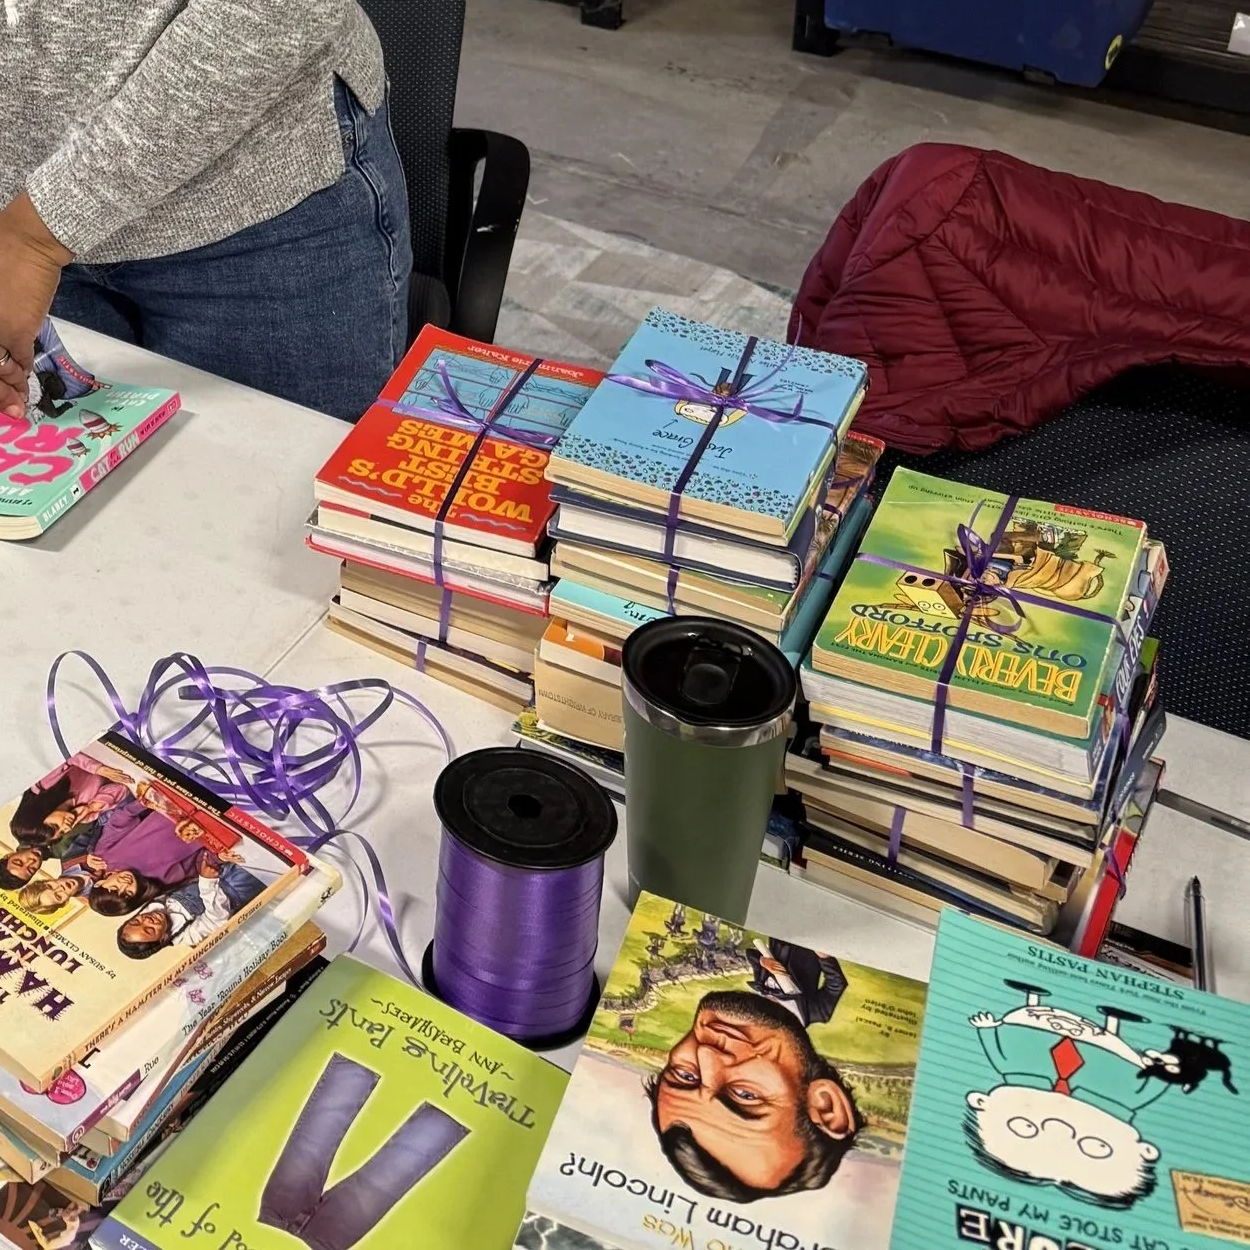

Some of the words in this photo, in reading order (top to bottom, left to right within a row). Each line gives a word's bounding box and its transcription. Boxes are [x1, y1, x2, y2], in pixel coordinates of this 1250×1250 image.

[651, 428, 694, 449] Grace
[41, 494, 69, 523] BLABEY
[1054, 505, 1128, 528] SCHOLASTIC
[834, 616, 950, 668] CLEARY
[850, 603, 1003, 649] SPOFFORD
[954, 643, 1084, 703] BEVERLY
[1011, 641, 1088, 669] OTIS
[228, 811, 286, 851] SCHOLASTIC
[13, 942, 40, 965] IN
[48, 927, 81, 957] CLYMER
[188, 924, 230, 966] LUNCHBOX
[1026, 944, 1090, 975] PASTIS
[78, 951, 107, 976] SUSAN
[181, 1019, 198, 1037] The
[197, 1001, 217, 1020] Year
[242, 950, 270, 981] Holiday
[1094, 966, 1187, 1002] STEPHAN
[318, 998, 396, 1051] Pants
[381, 1000, 467, 1055] BRASHARES
[467, 1050, 504, 1076] ANN
[401, 1035, 537, 1130] Traveling
[145, 1180, 186, 1228] the
[559, 1151, 699, 1225] Lincoln?
[946, 1178, 1012, 1212] PANTS
[180, 1202, 221, 1239] of
[1017, 1202, 1050, 1225] MY
[1057, 1213, 1124, 1246] STOLE
